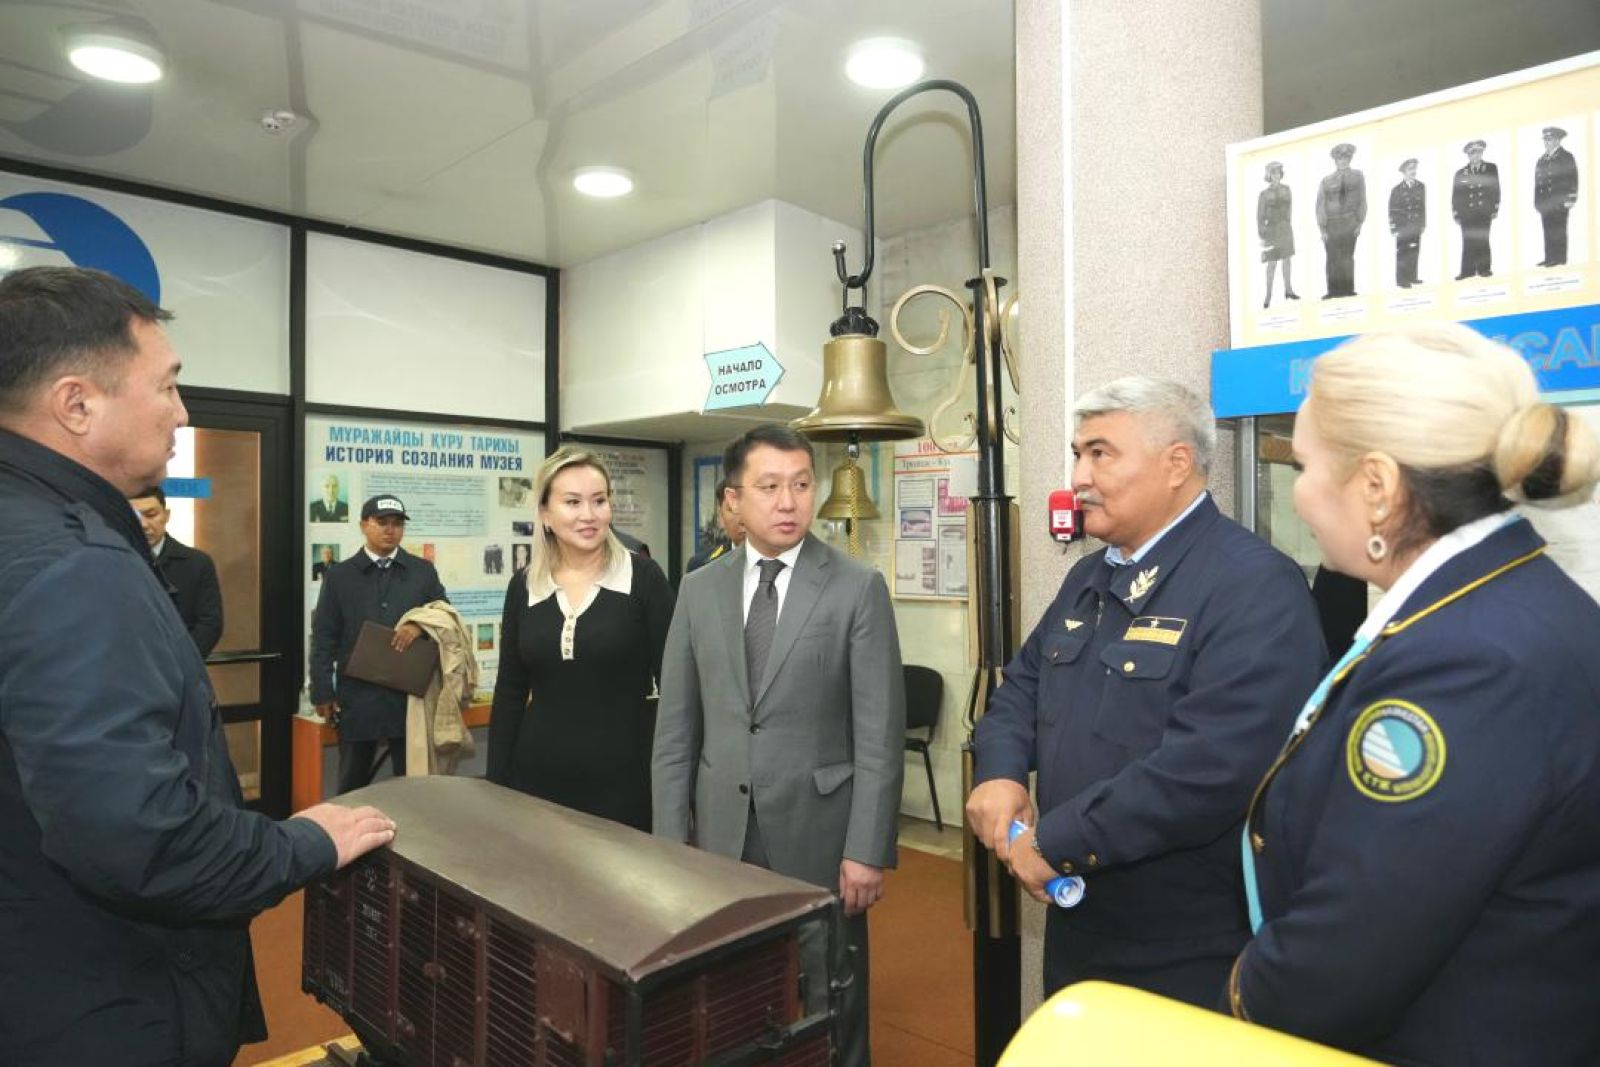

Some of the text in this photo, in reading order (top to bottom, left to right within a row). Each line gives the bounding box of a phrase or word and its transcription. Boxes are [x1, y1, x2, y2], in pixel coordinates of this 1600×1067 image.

[718, 359, 763, 376] НАЧАЛО
[715, 378, 767, 395] ОСМОТРА
[470, 436, 520, 454] ТАРИХЫ
[325, 446, 522, 471] ИСТОРИЯ СОЗДАНИЯ МУЗЕЯ
